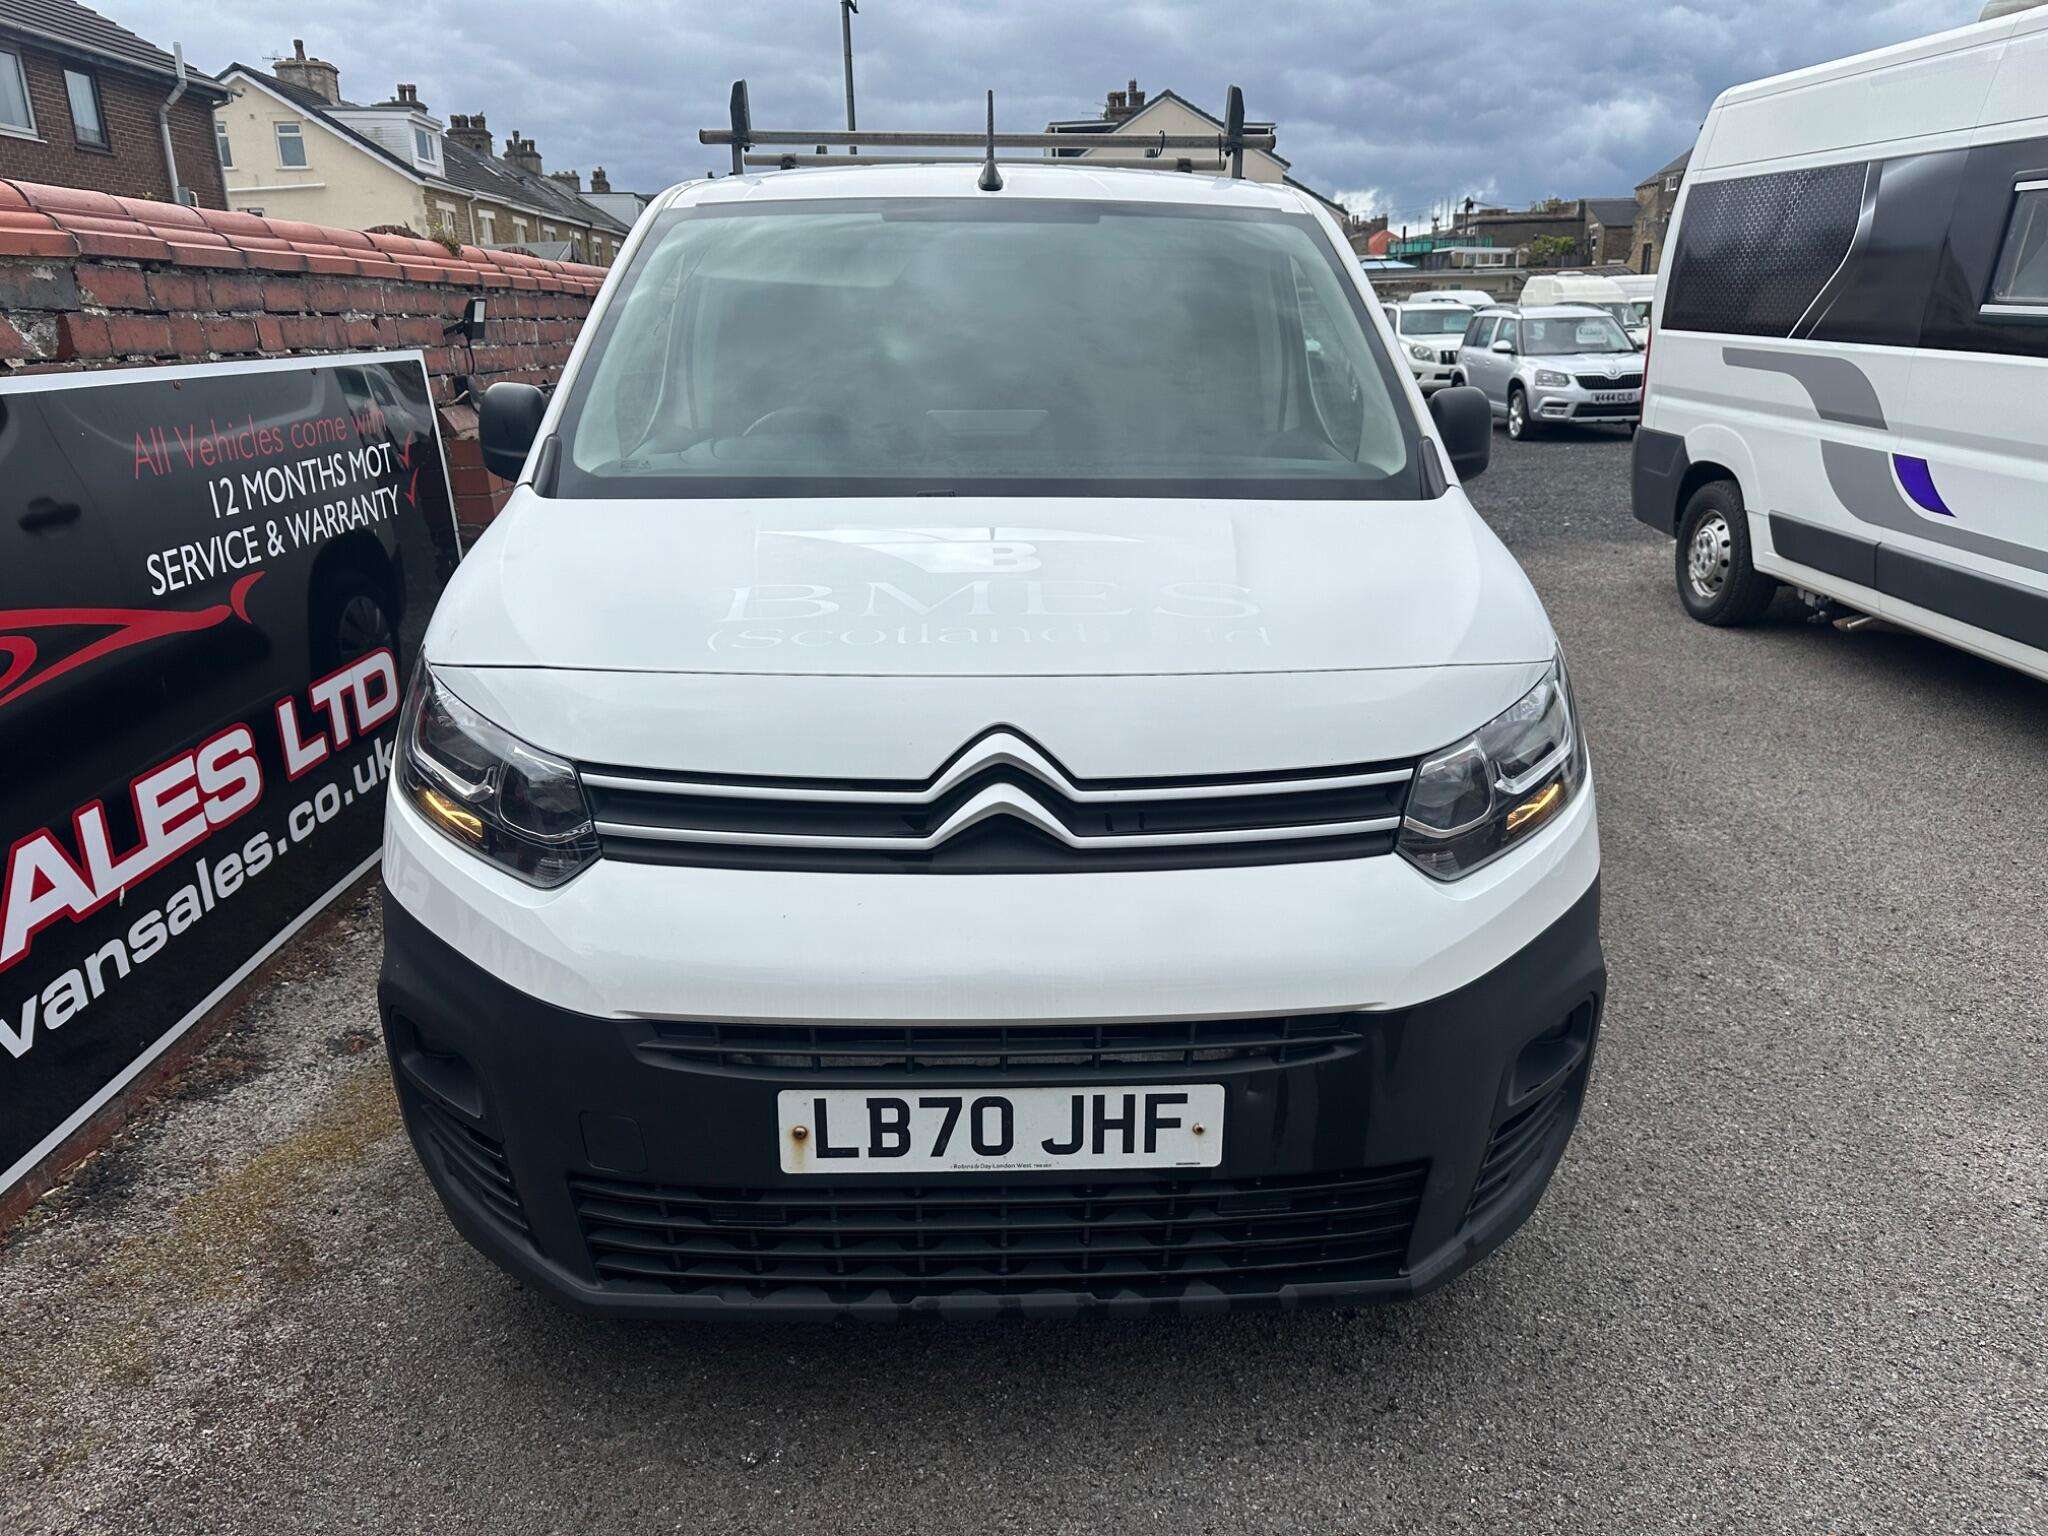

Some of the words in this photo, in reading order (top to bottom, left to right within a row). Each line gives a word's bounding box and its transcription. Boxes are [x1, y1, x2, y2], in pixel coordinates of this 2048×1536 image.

[133, 426, 172, 479] All
[174, 415, 284, 472] Vehicles
[290, 415, 347, 449] come
[351, 401, 387, 438] with
[208, 475, 240, 519] 12
[242, 453, 347, 510] MONTHS
[347, 442, 392, 483] MOT
[146, 524, 262, 597] SERVICE
[266, 521, 285, 558] &
[284, 484, 400, 549] WARRANTY
[711, 579, 1263, 624] BMES
[274, 646, 401, 782] LTD
[813, 1096, 1014, 1159] LB70
[1041, 1093, 1189, 1155] JHF
[992, 1161, 1016, 1169] London
